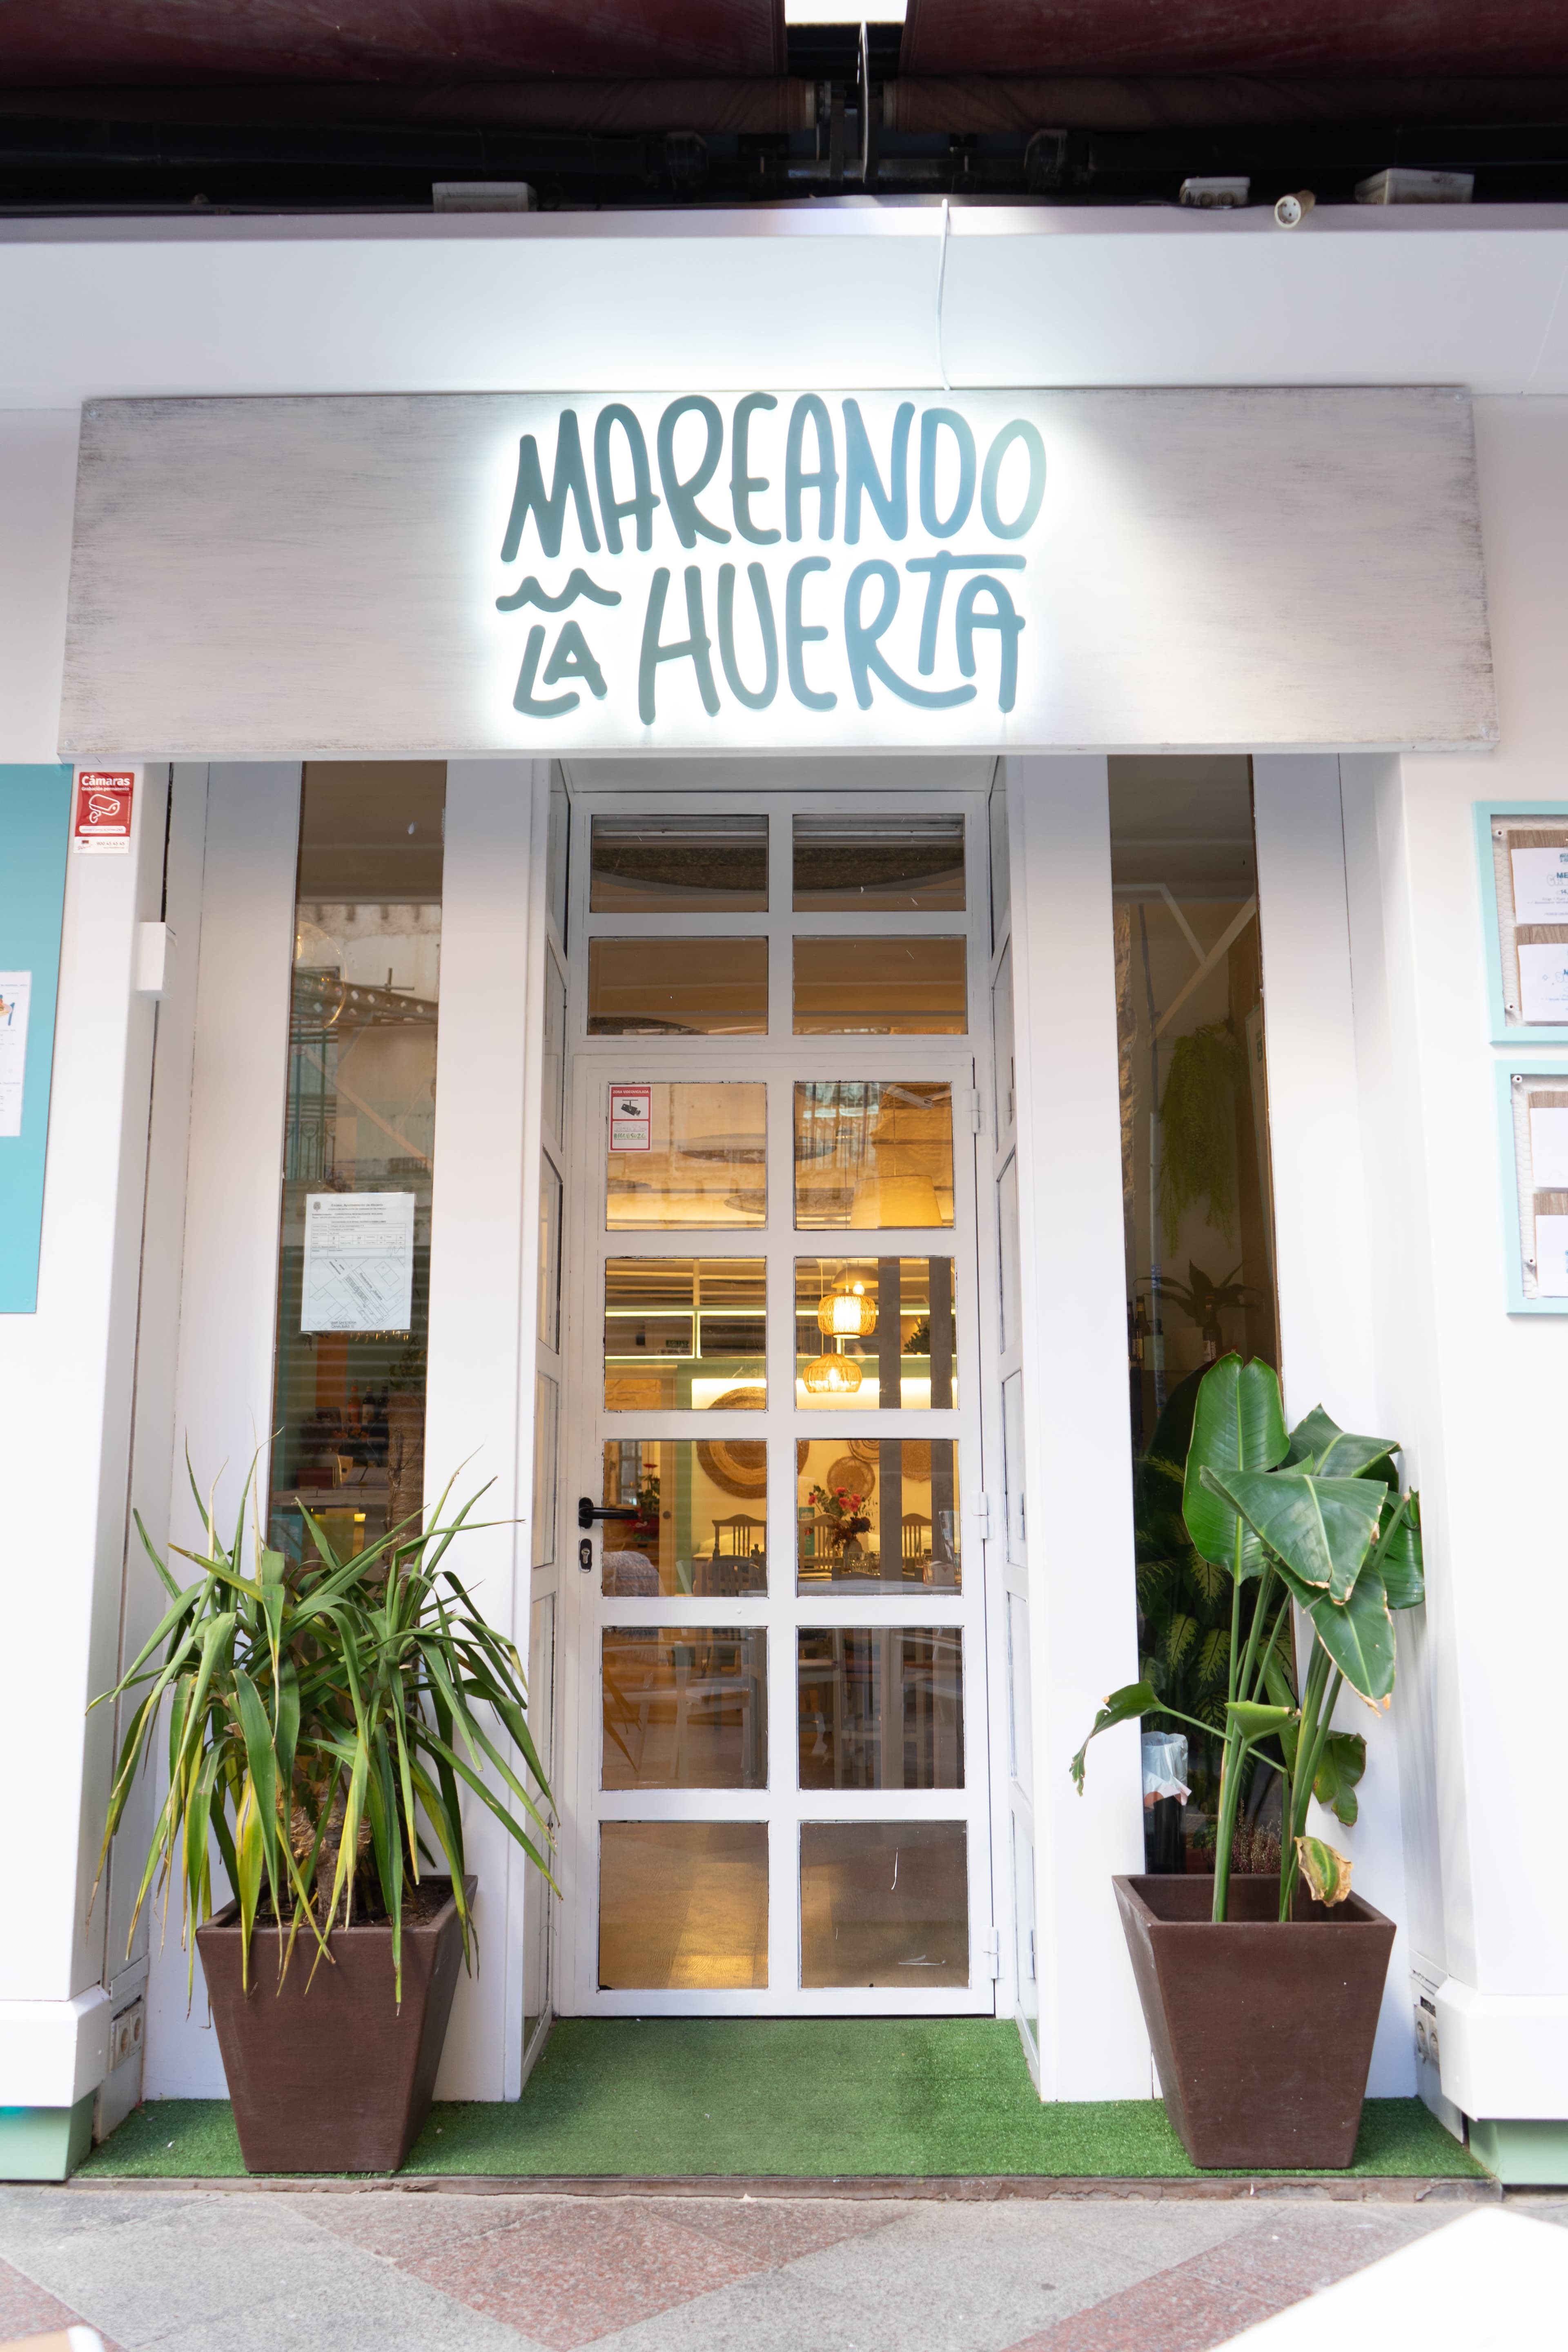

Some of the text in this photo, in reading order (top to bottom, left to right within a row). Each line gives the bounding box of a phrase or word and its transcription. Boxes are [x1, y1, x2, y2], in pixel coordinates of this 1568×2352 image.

[500, 392, 1047, 562] MAREANDO
[513, 550, 1027, 725] LA HUERTA
[82, 775, 130, 786] Cámaras
